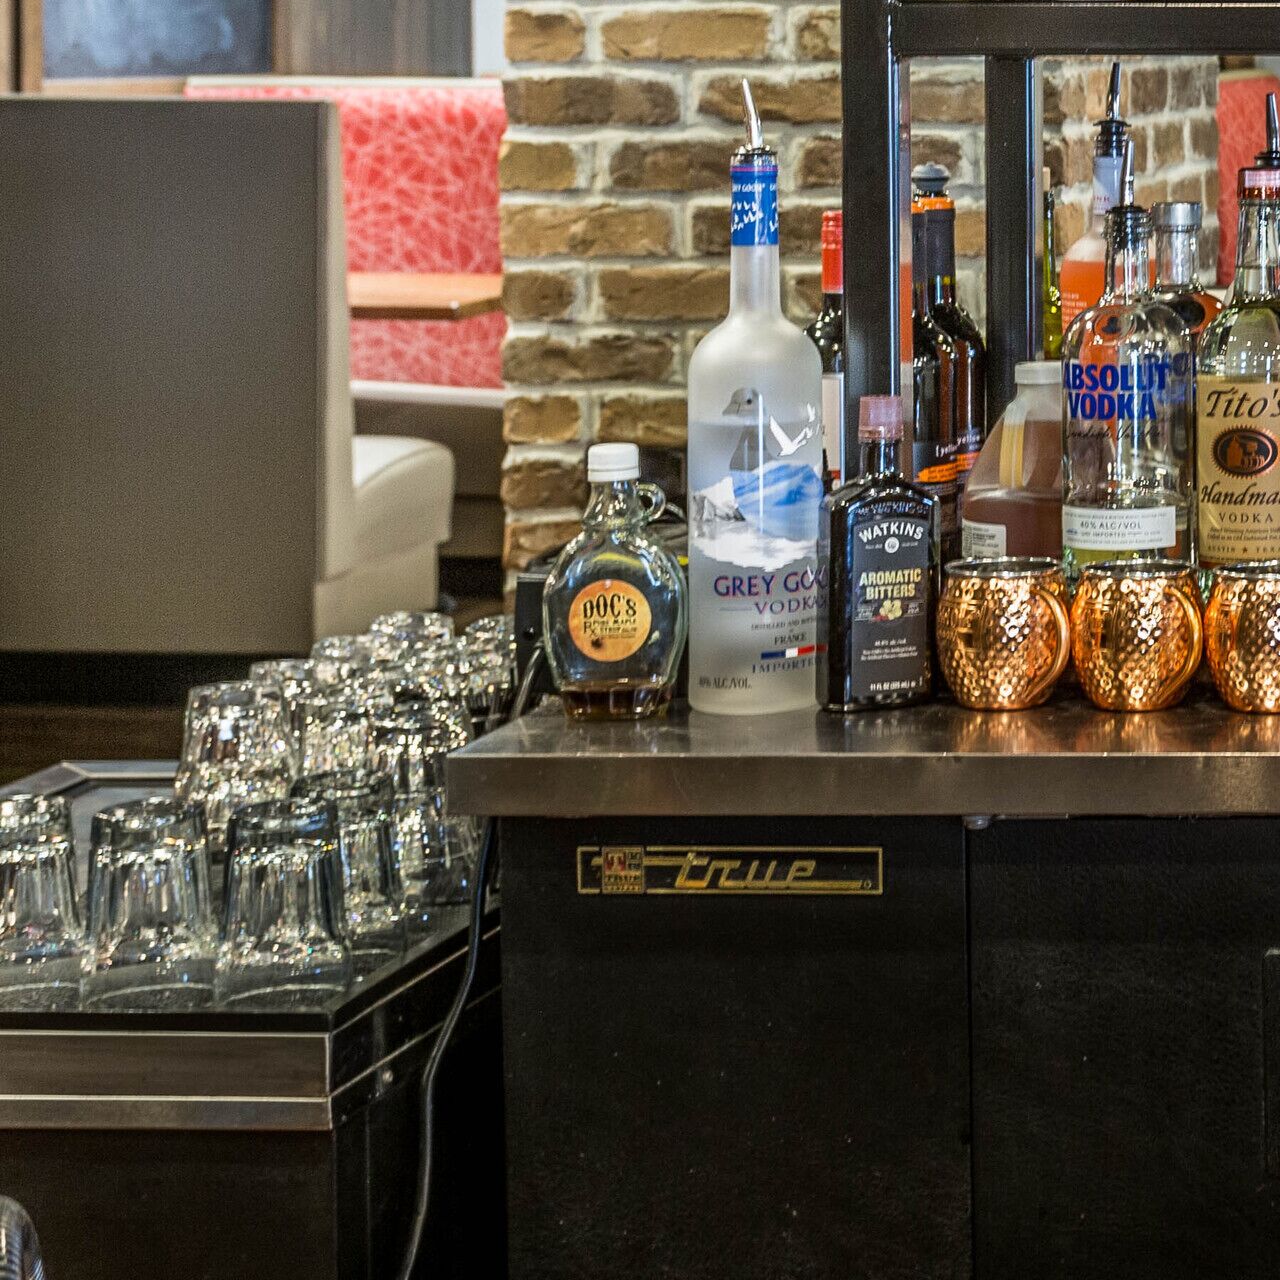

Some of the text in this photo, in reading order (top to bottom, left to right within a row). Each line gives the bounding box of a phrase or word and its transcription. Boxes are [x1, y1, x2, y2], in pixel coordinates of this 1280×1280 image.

[1068, 391, 1157, 421] VODKA
[1218, 512, 1275, 523] VODKA
[858, 522, 924, 544] WATKINS
[713, 574, 776, 598] GREY
[858, 567, 922, 587] AROMATIC
[865, 584, 916, 601] BITTERS
[583, 593, 637, 619] DOC'S
